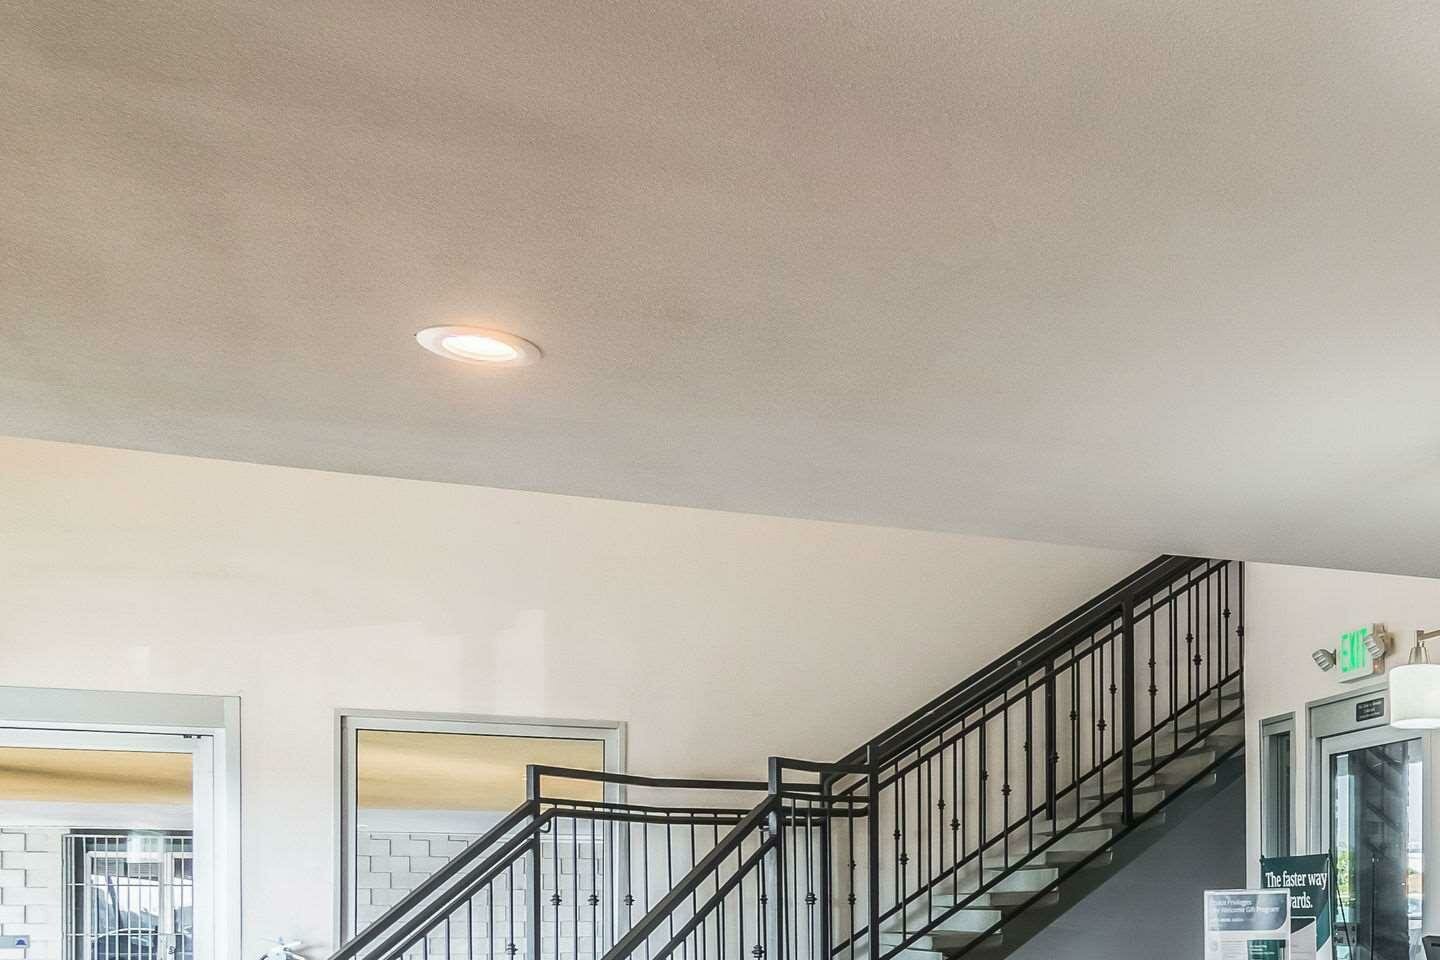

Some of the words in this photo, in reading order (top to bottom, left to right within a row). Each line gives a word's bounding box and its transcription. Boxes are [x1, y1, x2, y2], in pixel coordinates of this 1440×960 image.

[1341, 627, 1367, 673] EXIT
[1265, 871, 1282, 888] The
[1282, 870, 1306, 888] faster
[1307, 871, 1328, 890] way
[1289, 891, 1313, 909] ards.
